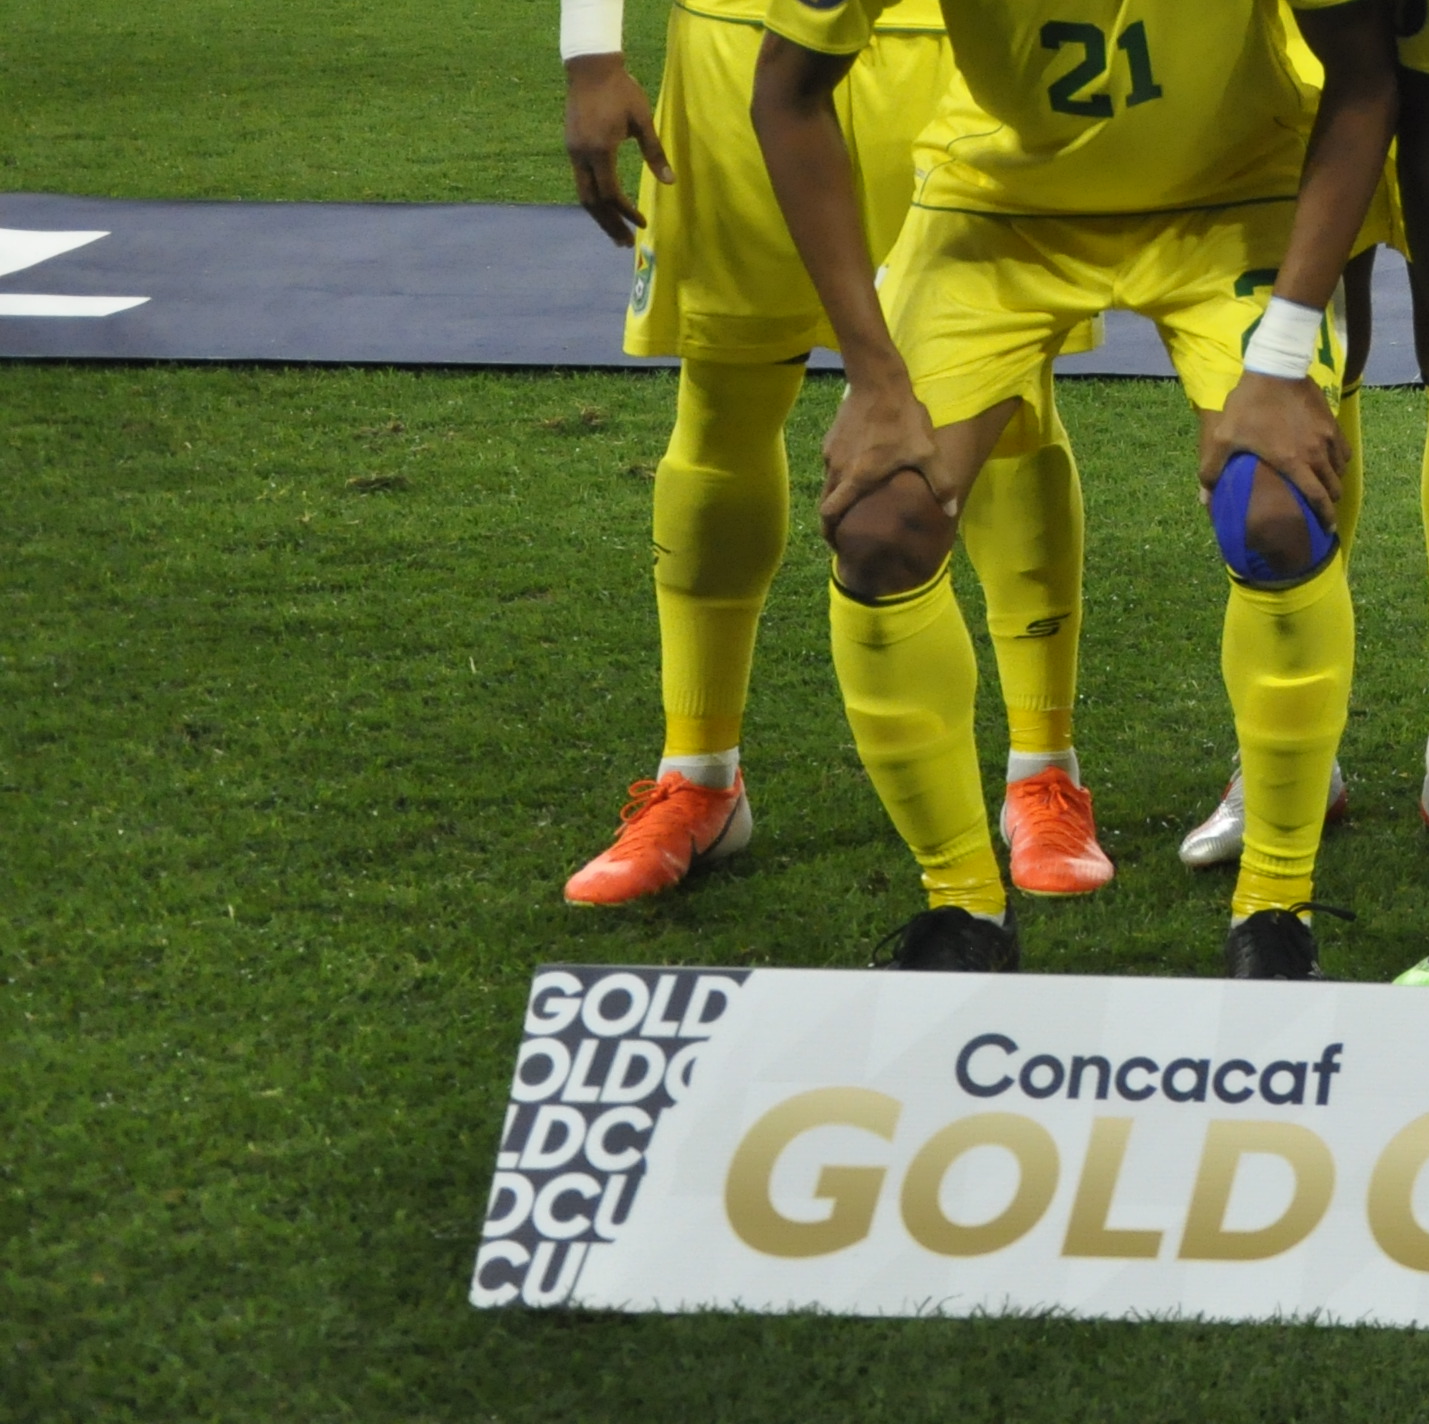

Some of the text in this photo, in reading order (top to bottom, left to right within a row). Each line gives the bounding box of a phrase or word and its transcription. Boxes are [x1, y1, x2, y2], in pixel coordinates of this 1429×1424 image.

[1040, 19, 1163, 119] 21
[524, 970, 740, 1038] GOLD
[955, 1033, 1343, 1106] Concacaf
[724, 1084, 1337, 1263] GOLD
